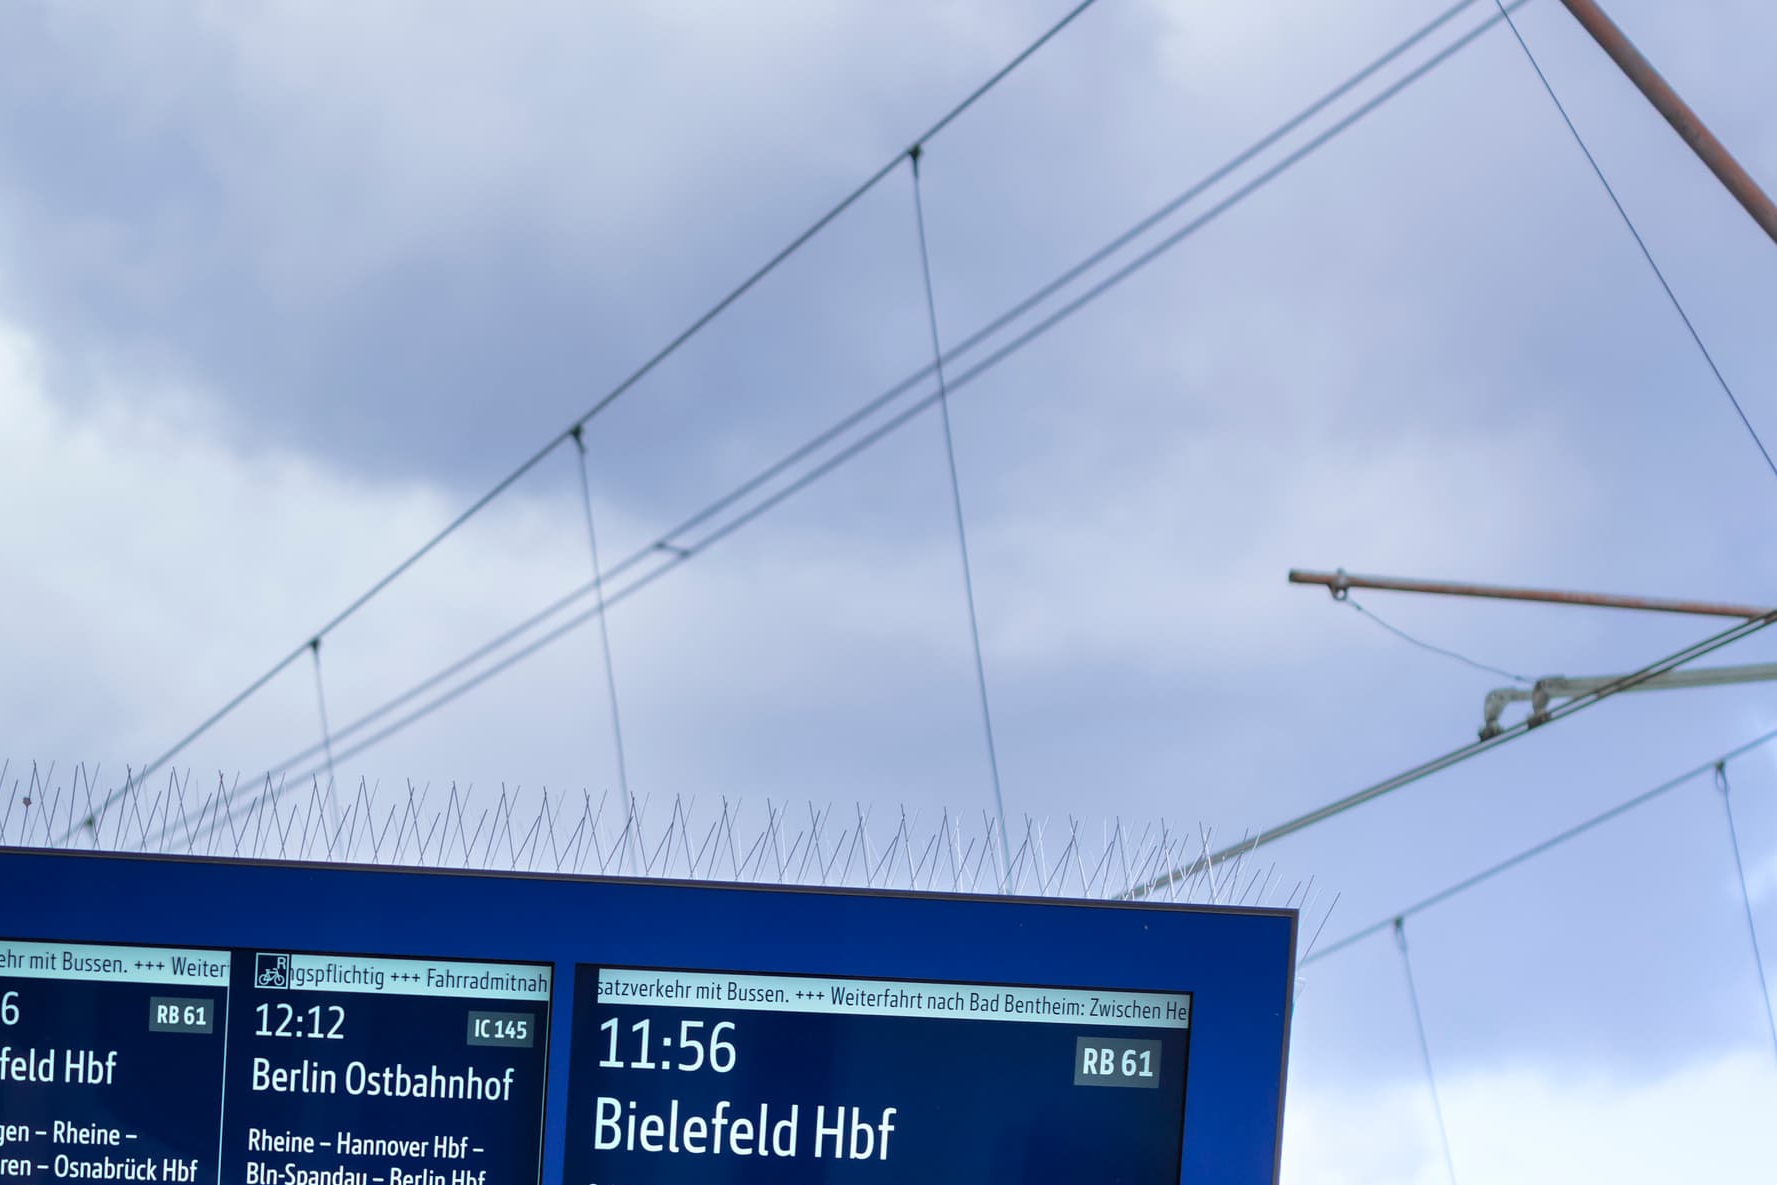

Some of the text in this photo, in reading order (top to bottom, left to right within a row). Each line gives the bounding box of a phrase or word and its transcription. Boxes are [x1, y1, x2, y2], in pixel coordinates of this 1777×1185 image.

[29, 951, 57, 971] mit
[62, 950, 128, 974] Bussen.
[134, 960, 165, 971] +++
[171, 956, 229, 979] Weiter
[390, 972, 421, 983] +++
[427, 968, 547, 993] Fahrradmitnah
[157, 1004, 207, 1026] RB 61
[695, 981, 723, 1001] mit
[726, 981, 790, 1004] Bussen.
[794, 989, 826, 1001] +++
[829, 985, 923, 1010] Weiterfahrt
[926, 990, 965, 1011] nach
[969, 992, 1000, 1013] Bad
[1003, 994, 1085, 1017] Bentheim:
[1088, 997, 1162, 1020] Zwischen
[1165, 1001, 1187, 1021] He
[255, 1003, 346, 1040] 12:12
[474, 1018, 527, 1040] IC 145
[598, 1017, 737, 1073] 11:56
[65, 1049, 118, 1085] Hbf
[1082, 1047, 1153, 1078] RB 61
[252, 1057, 515, 1101] Berlin Ostbahnhof
[53, 1120, 120, 1146] Rheine
[248, 1128, 315, 1154] Rheine
[337, 1131, 429, 1158] Hannover
[433, 1135, 469, 1159] Hbf
[594, 1096, 898, 1161] Bielefeld Hbf
[54, 1154, 157, 1181] Osnabrück
[162, 1158, 199, 1183] Hbf
